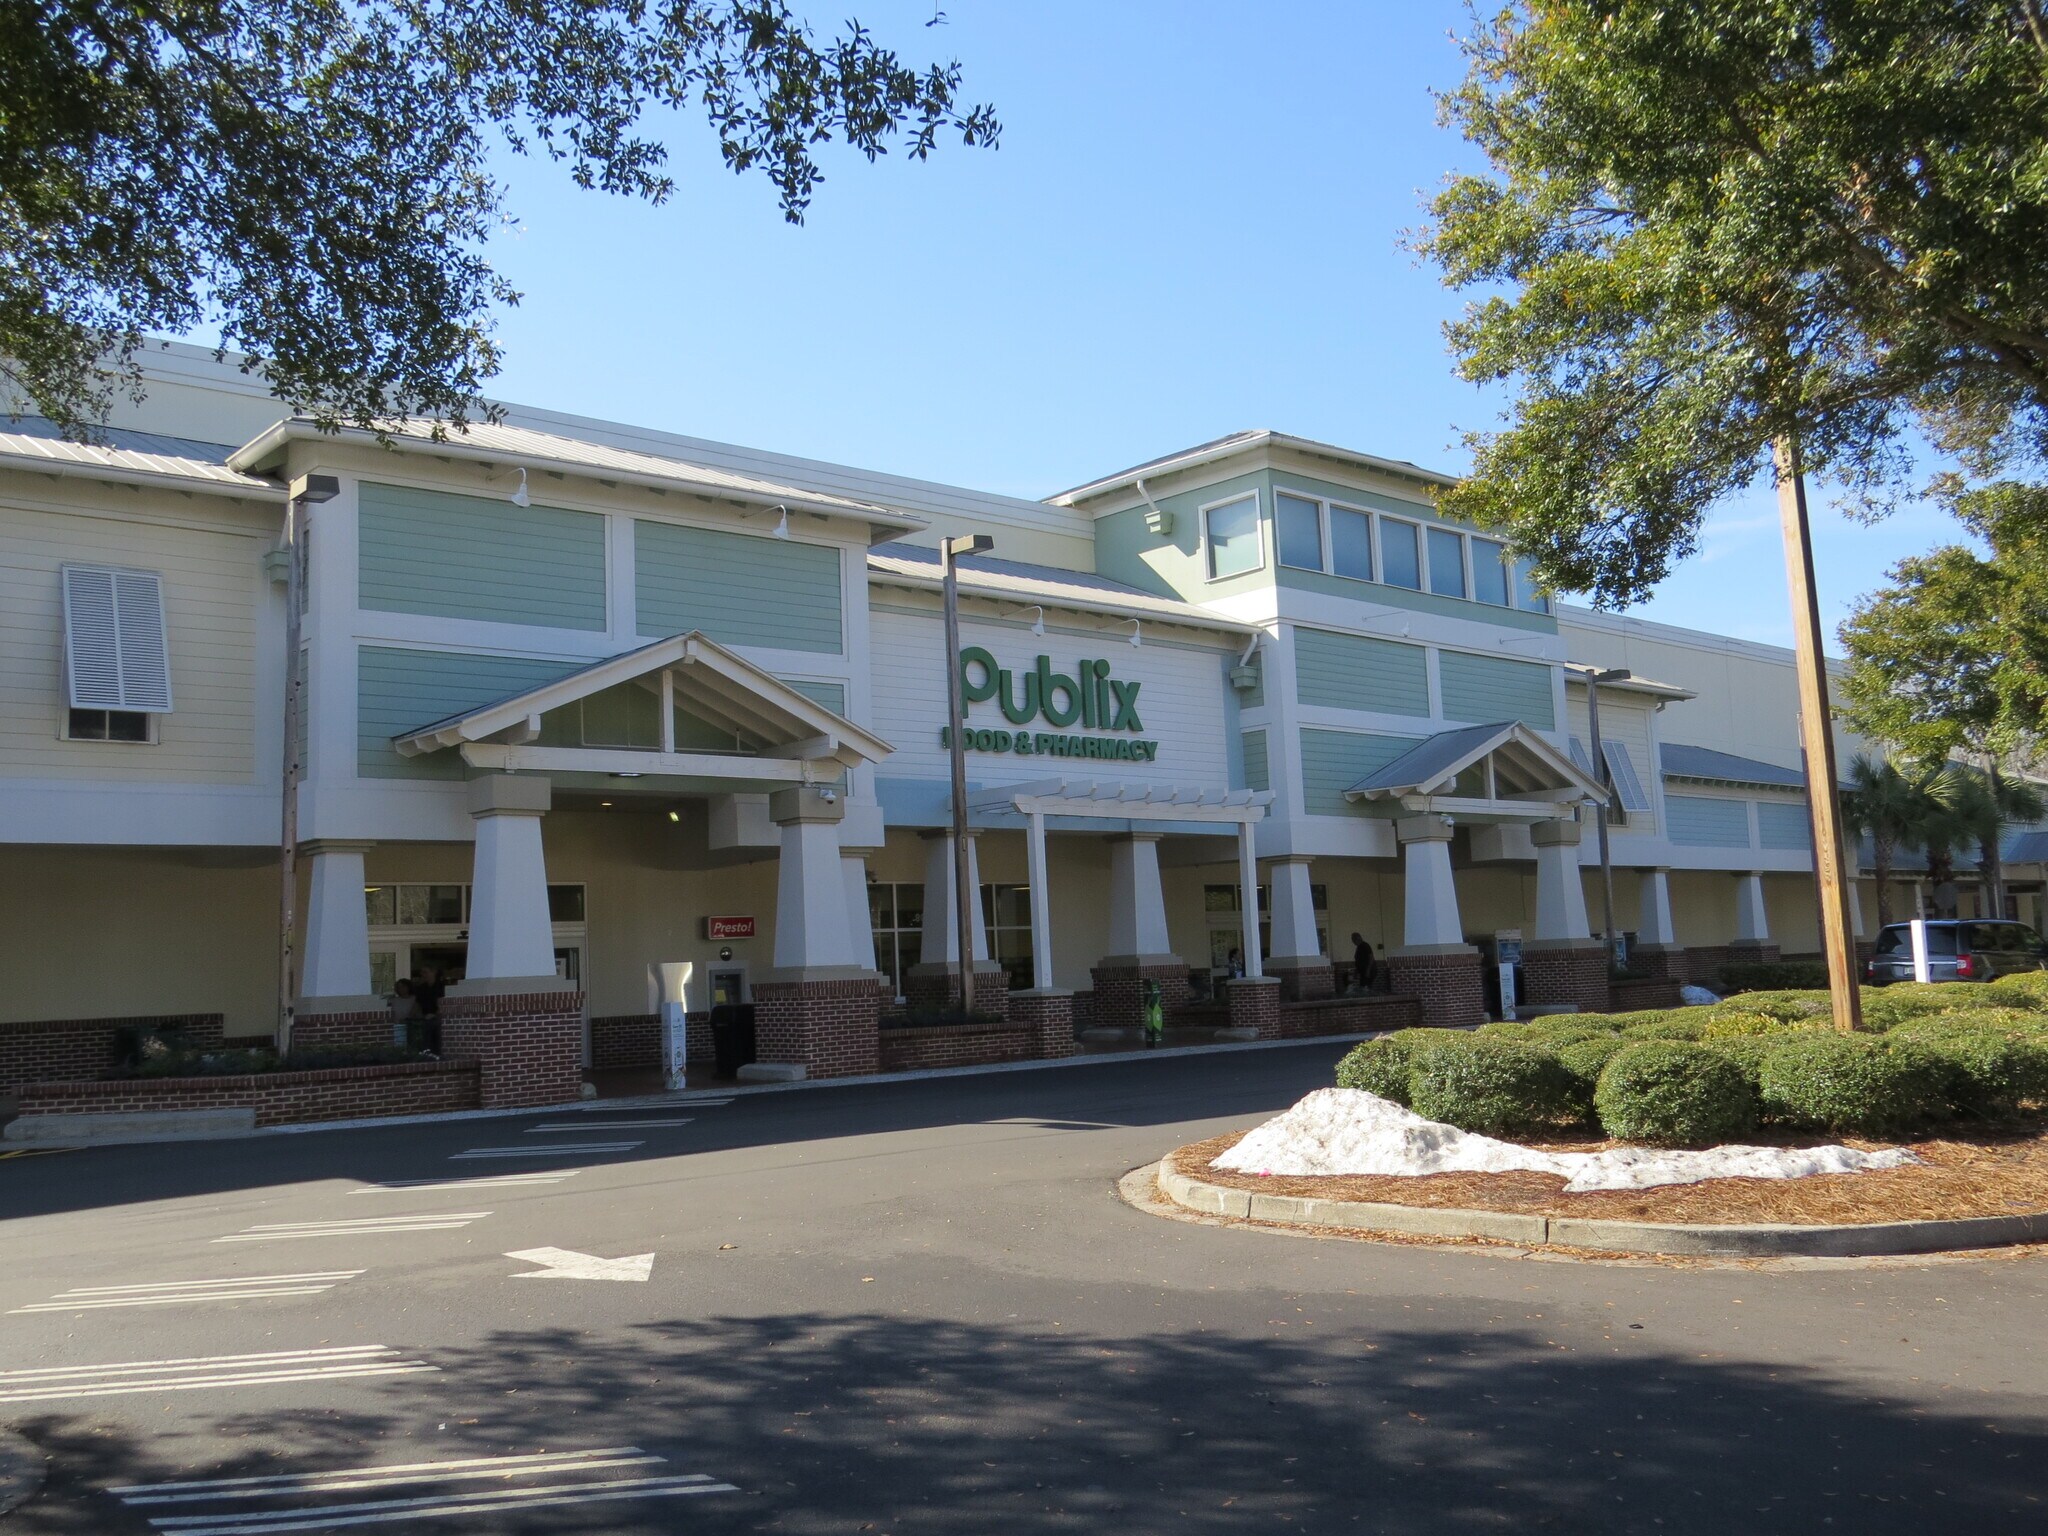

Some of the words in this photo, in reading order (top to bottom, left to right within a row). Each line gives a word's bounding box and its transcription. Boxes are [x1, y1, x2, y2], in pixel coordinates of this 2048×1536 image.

[959, 646, 1143, 731] Publix
[1015, 731, 1034, 754] &
[1035, 733, 1158, 761] PHARMACY
[714, 922, 752, 933] Presto!
